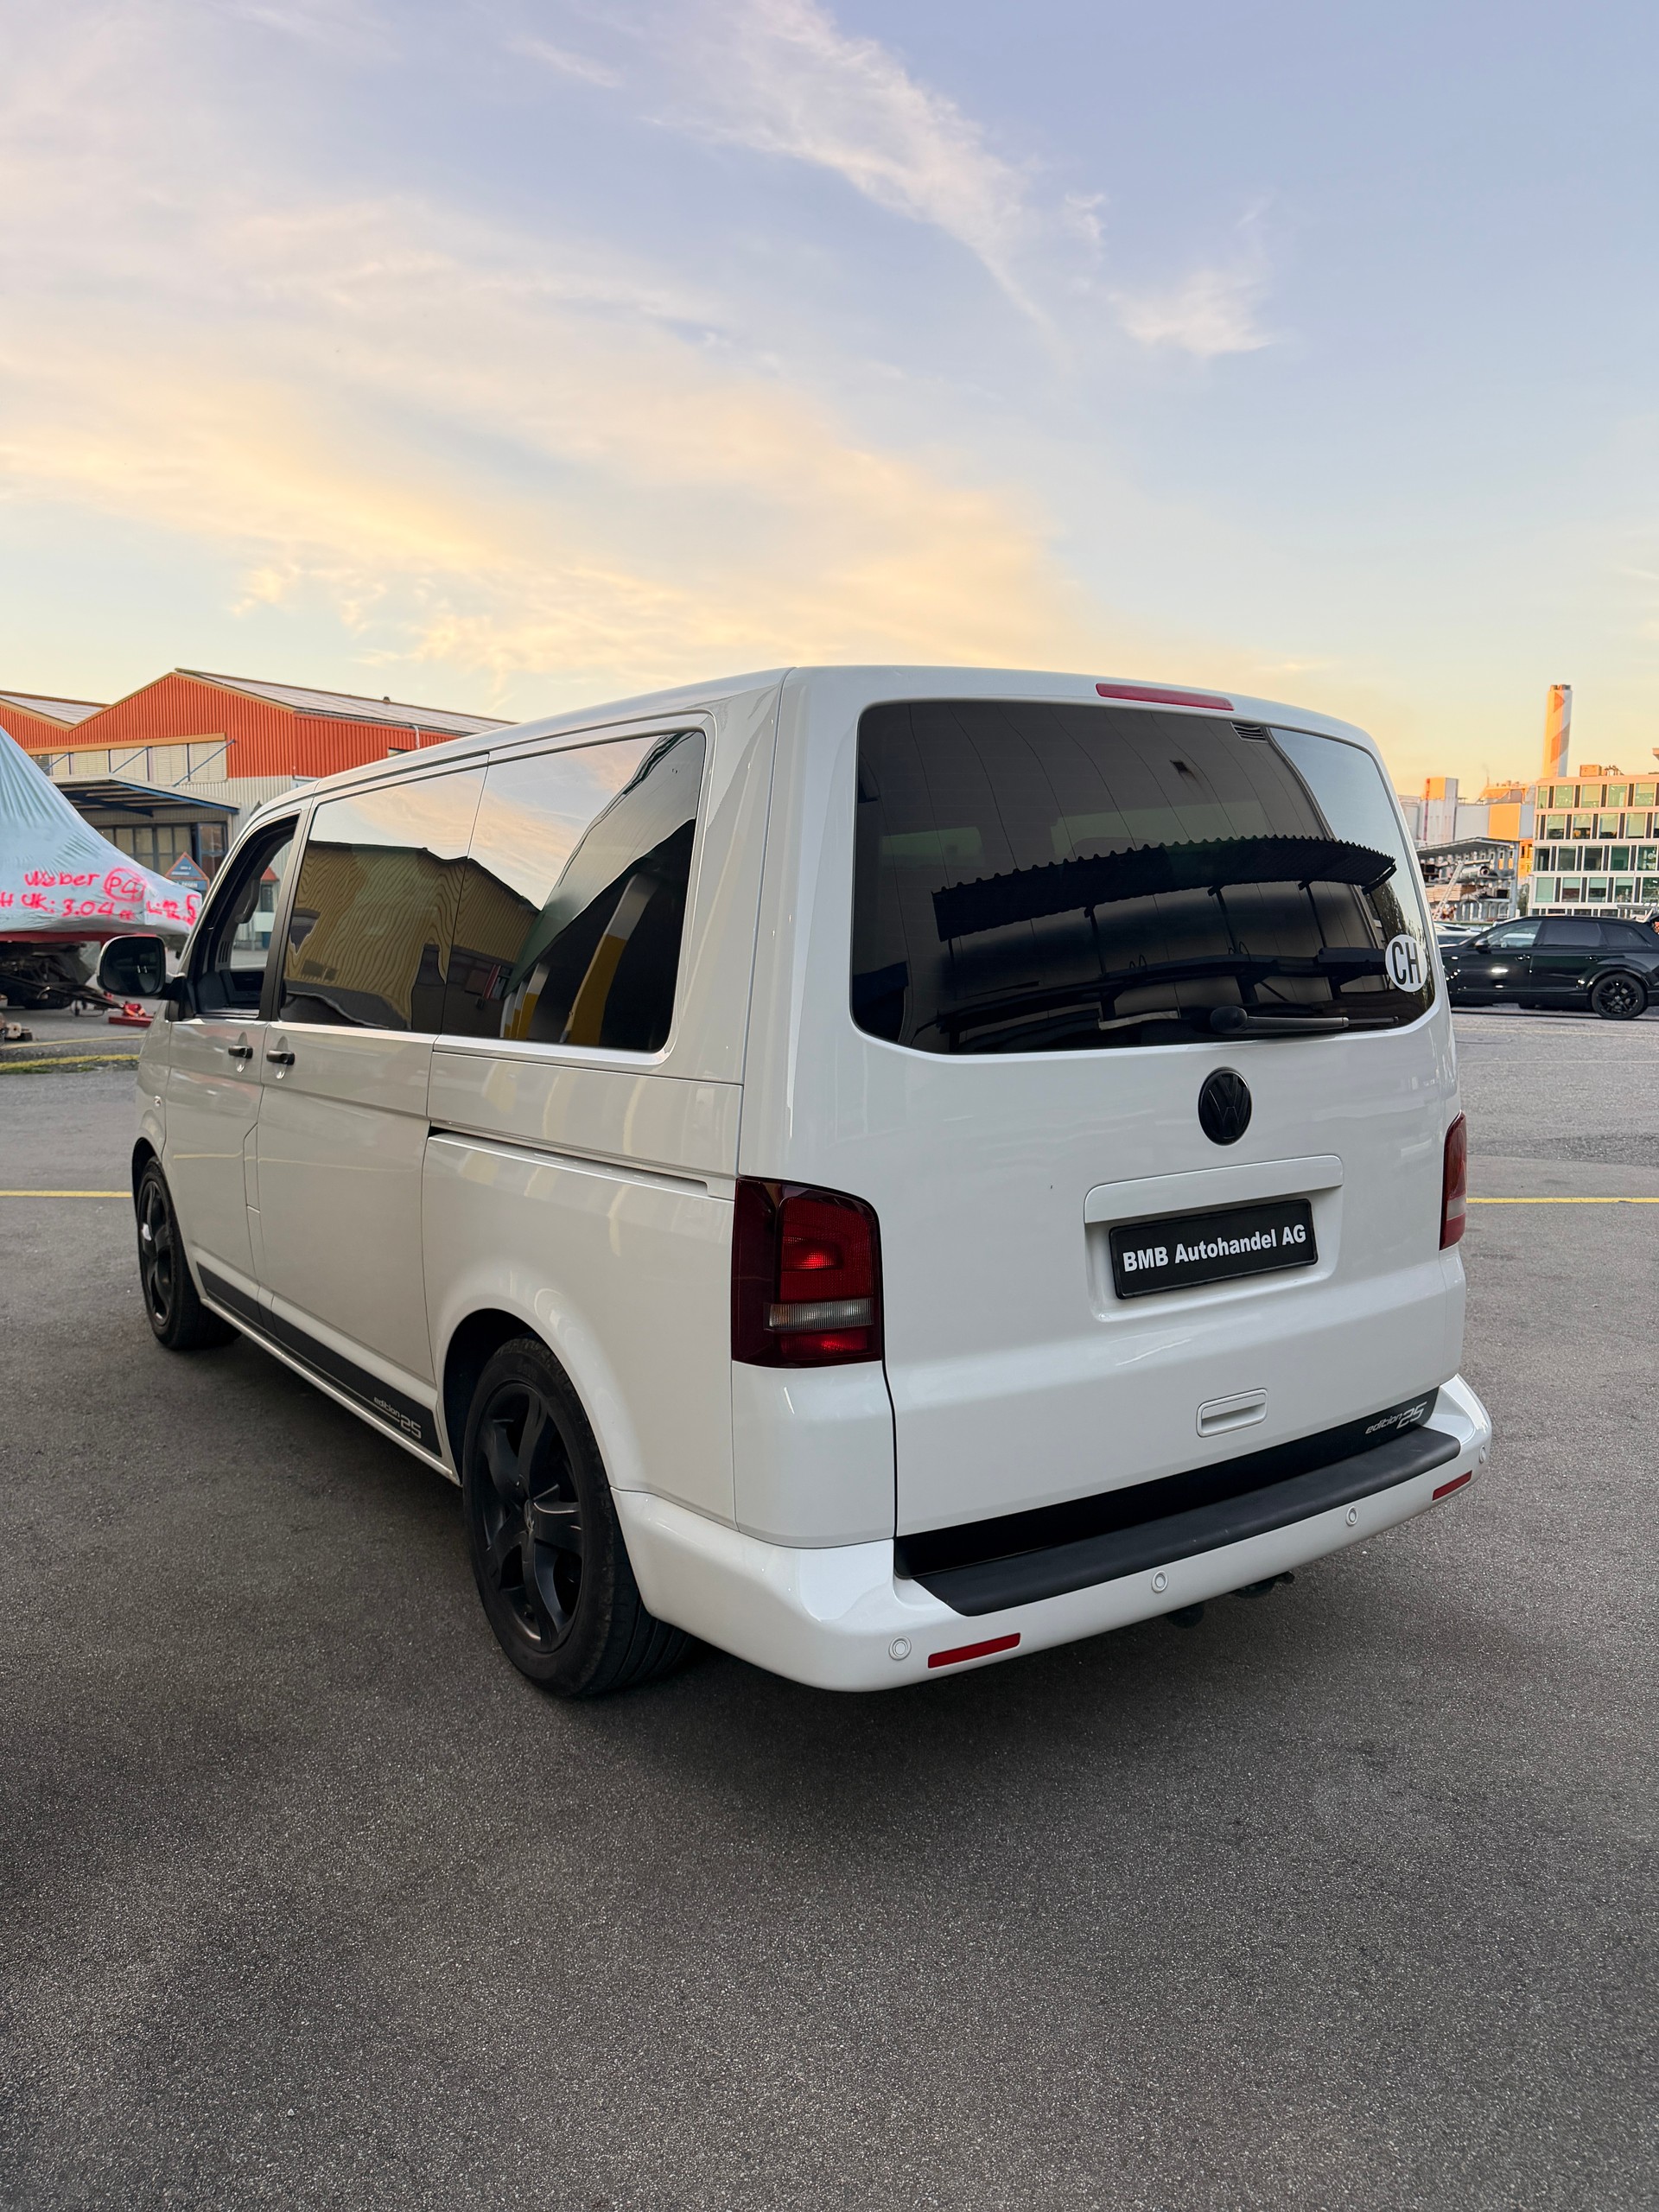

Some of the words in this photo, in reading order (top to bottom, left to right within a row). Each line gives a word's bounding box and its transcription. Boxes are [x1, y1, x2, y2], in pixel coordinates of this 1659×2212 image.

[61, 899, 115, 917] 3.04
[1392, 941, 1421, 985] CH
[1123, 1247, 1168, 1272] BMB
[1175, 1229, 1277, 1264] Autohandel
[1282, 1224, 1306, 1247] AG
